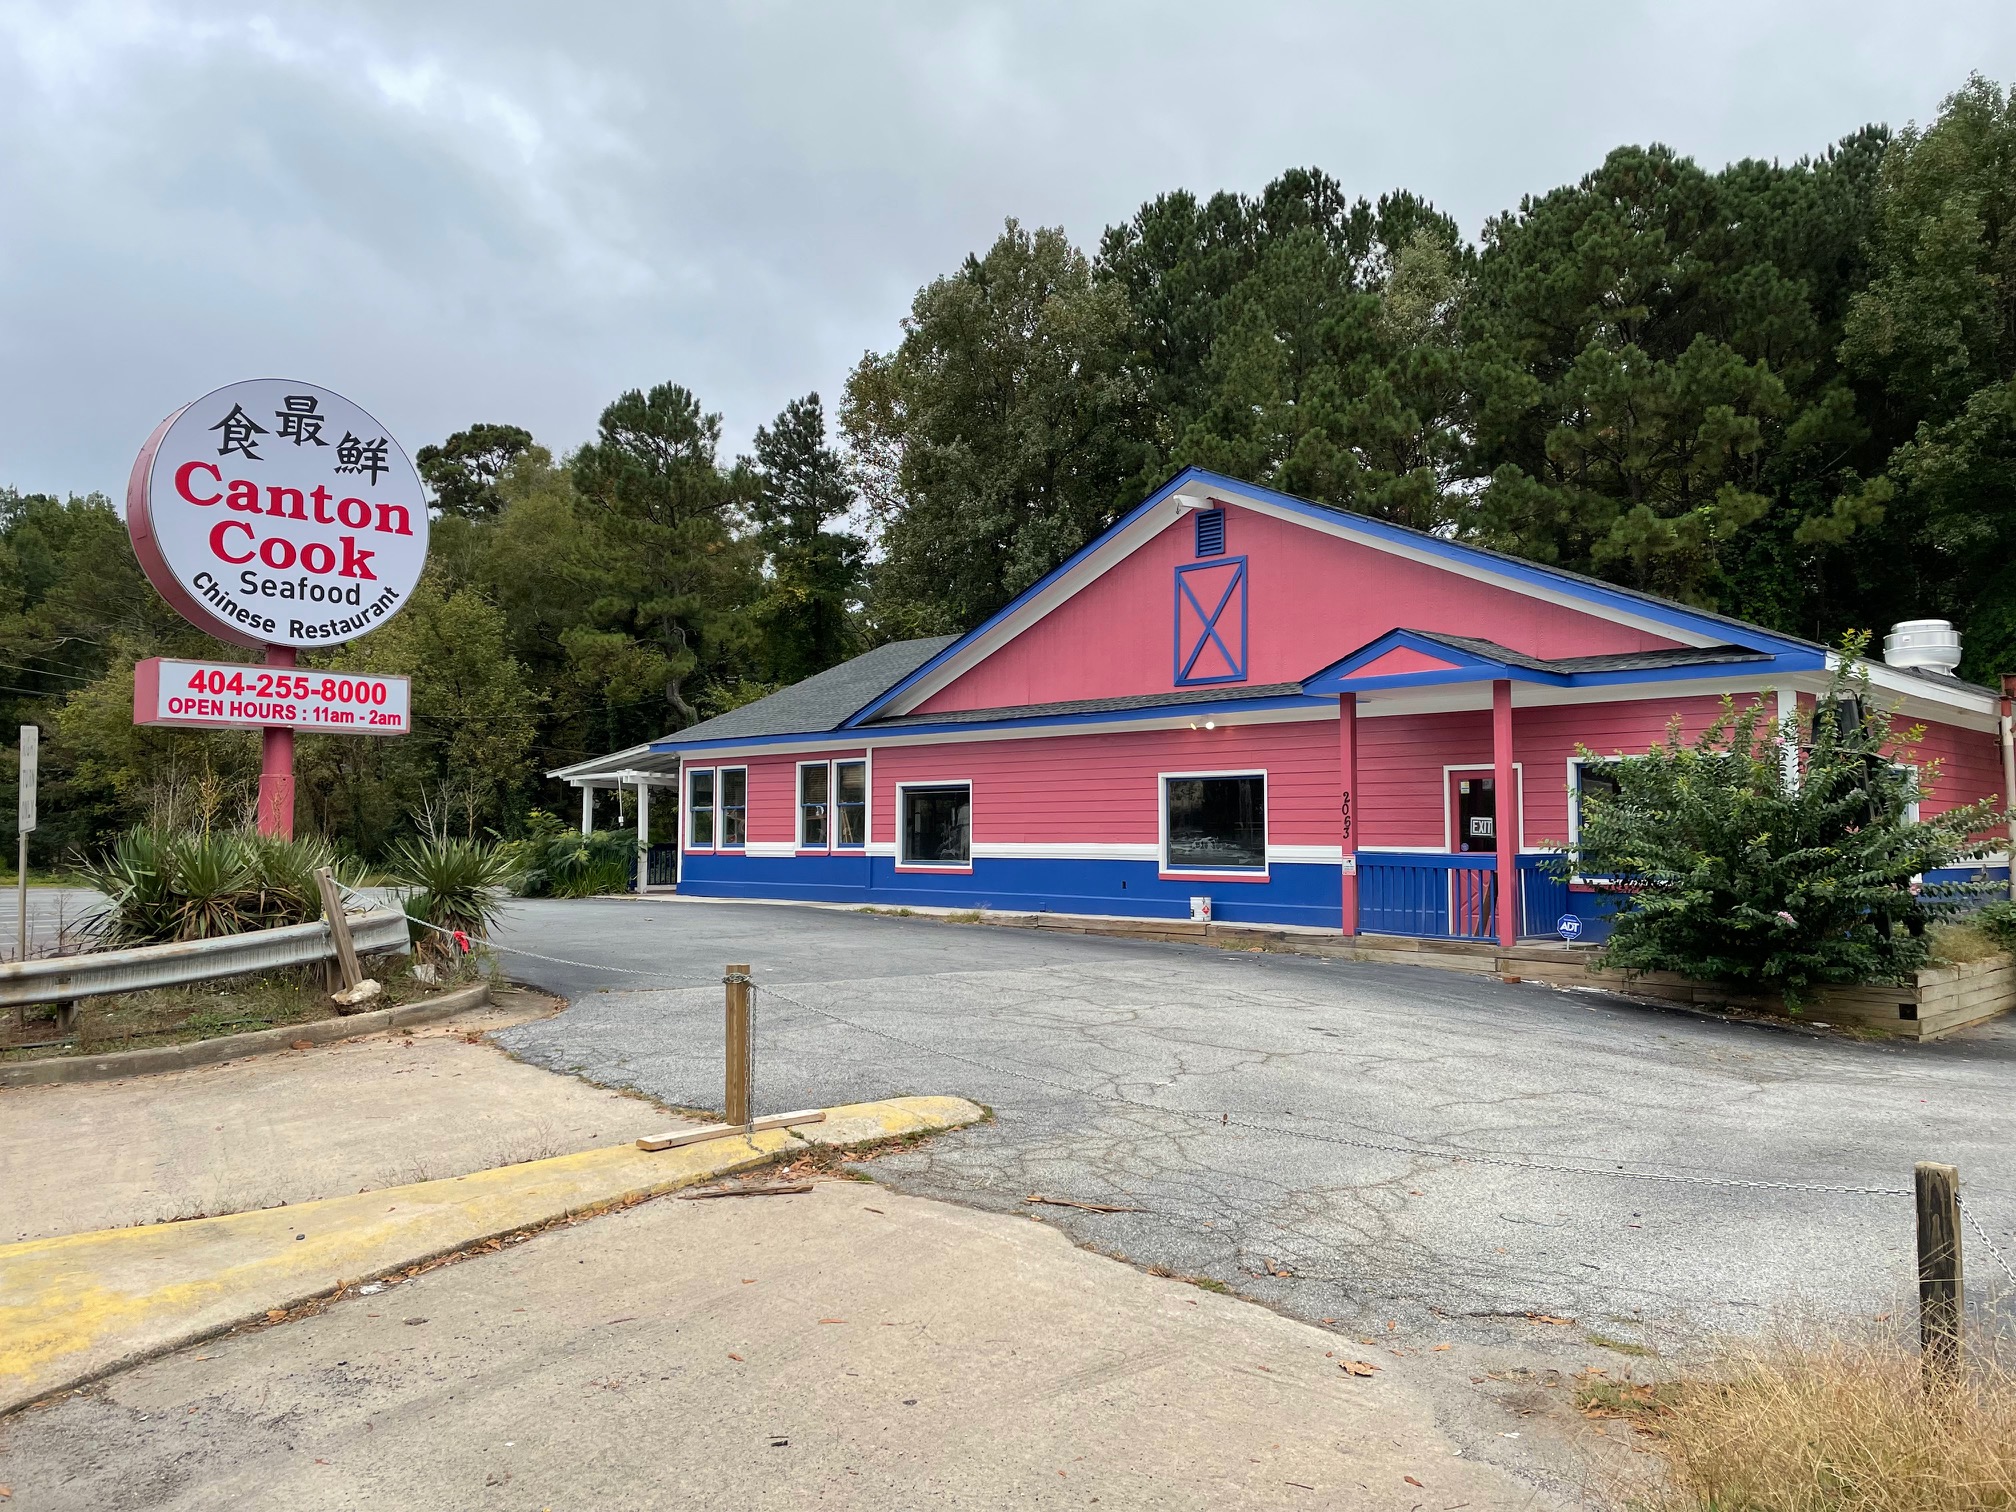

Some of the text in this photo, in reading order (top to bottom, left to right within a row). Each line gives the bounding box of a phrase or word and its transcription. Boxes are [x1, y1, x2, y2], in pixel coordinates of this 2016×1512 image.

[174, 461, 413, 536] Canton
[209, 520, 377, 580] Cook
[192, 571, 399, 639] Chinese Restaurant
[240, 570, 360, 606] Seafood
[188, 670, 387, 705] 404-255-8000
[168, 697, 223, 716] OPEN
[229, 700, 297, 720] HOURS
[312, 707, 354, 724] 11am
[369, 710, 401, 726] 2am
[1342, 792, 1351, 839] 2063
[1472, 820, 1492, 834] EXIT
[1560, 921, 1580, 932] ADT
